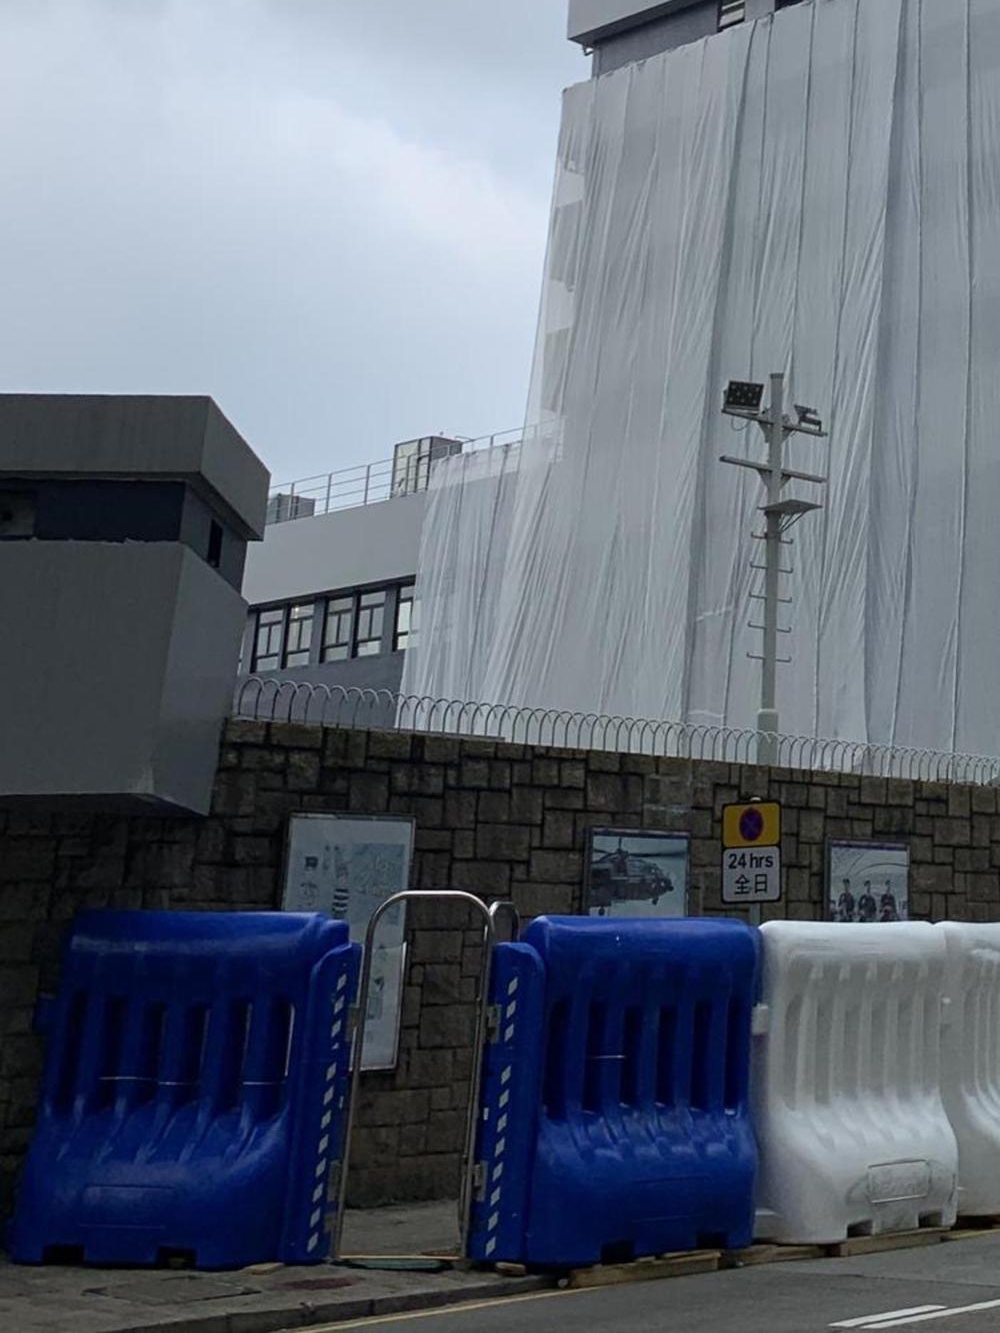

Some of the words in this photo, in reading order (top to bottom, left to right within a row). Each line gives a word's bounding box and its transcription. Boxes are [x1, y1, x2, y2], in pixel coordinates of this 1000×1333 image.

[728, 853, 747, 869] 24
[750, 852, 774, 868] hrs
[734, 874, 768, 895] 全日
